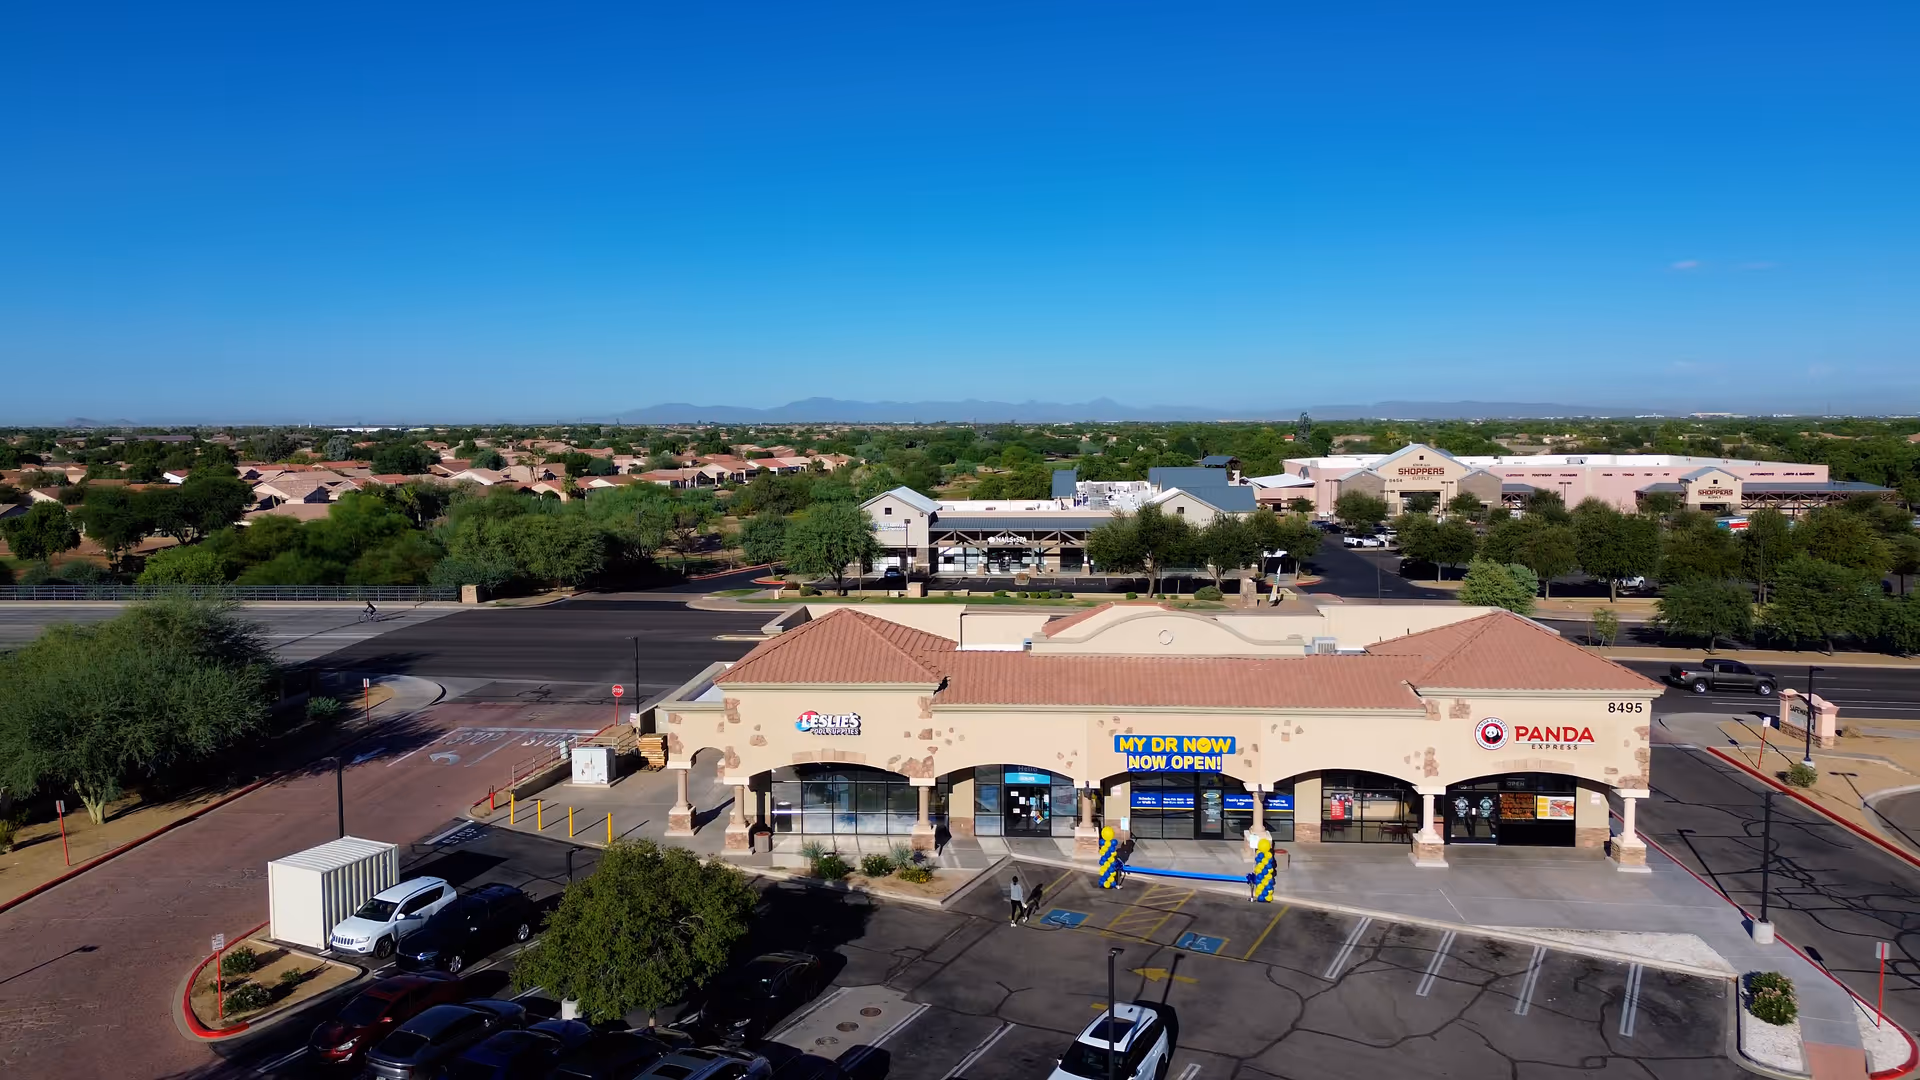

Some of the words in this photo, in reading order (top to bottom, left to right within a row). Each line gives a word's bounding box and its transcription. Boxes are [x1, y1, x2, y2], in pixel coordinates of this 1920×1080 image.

[1608, 702, 1642, 713] 8495
[802, 712, 860, 728] LESLIE'S
[1514, 726, 1594, 742] PANDA
[1120, 737, 1146, 752] MY
[1152, 738, 1178, 752] DR
[1183, 738, 1232, 753] NOW
[1128, 756, 1167, 770] NOW
[1171, 756, 1222, 770] OPEN!
